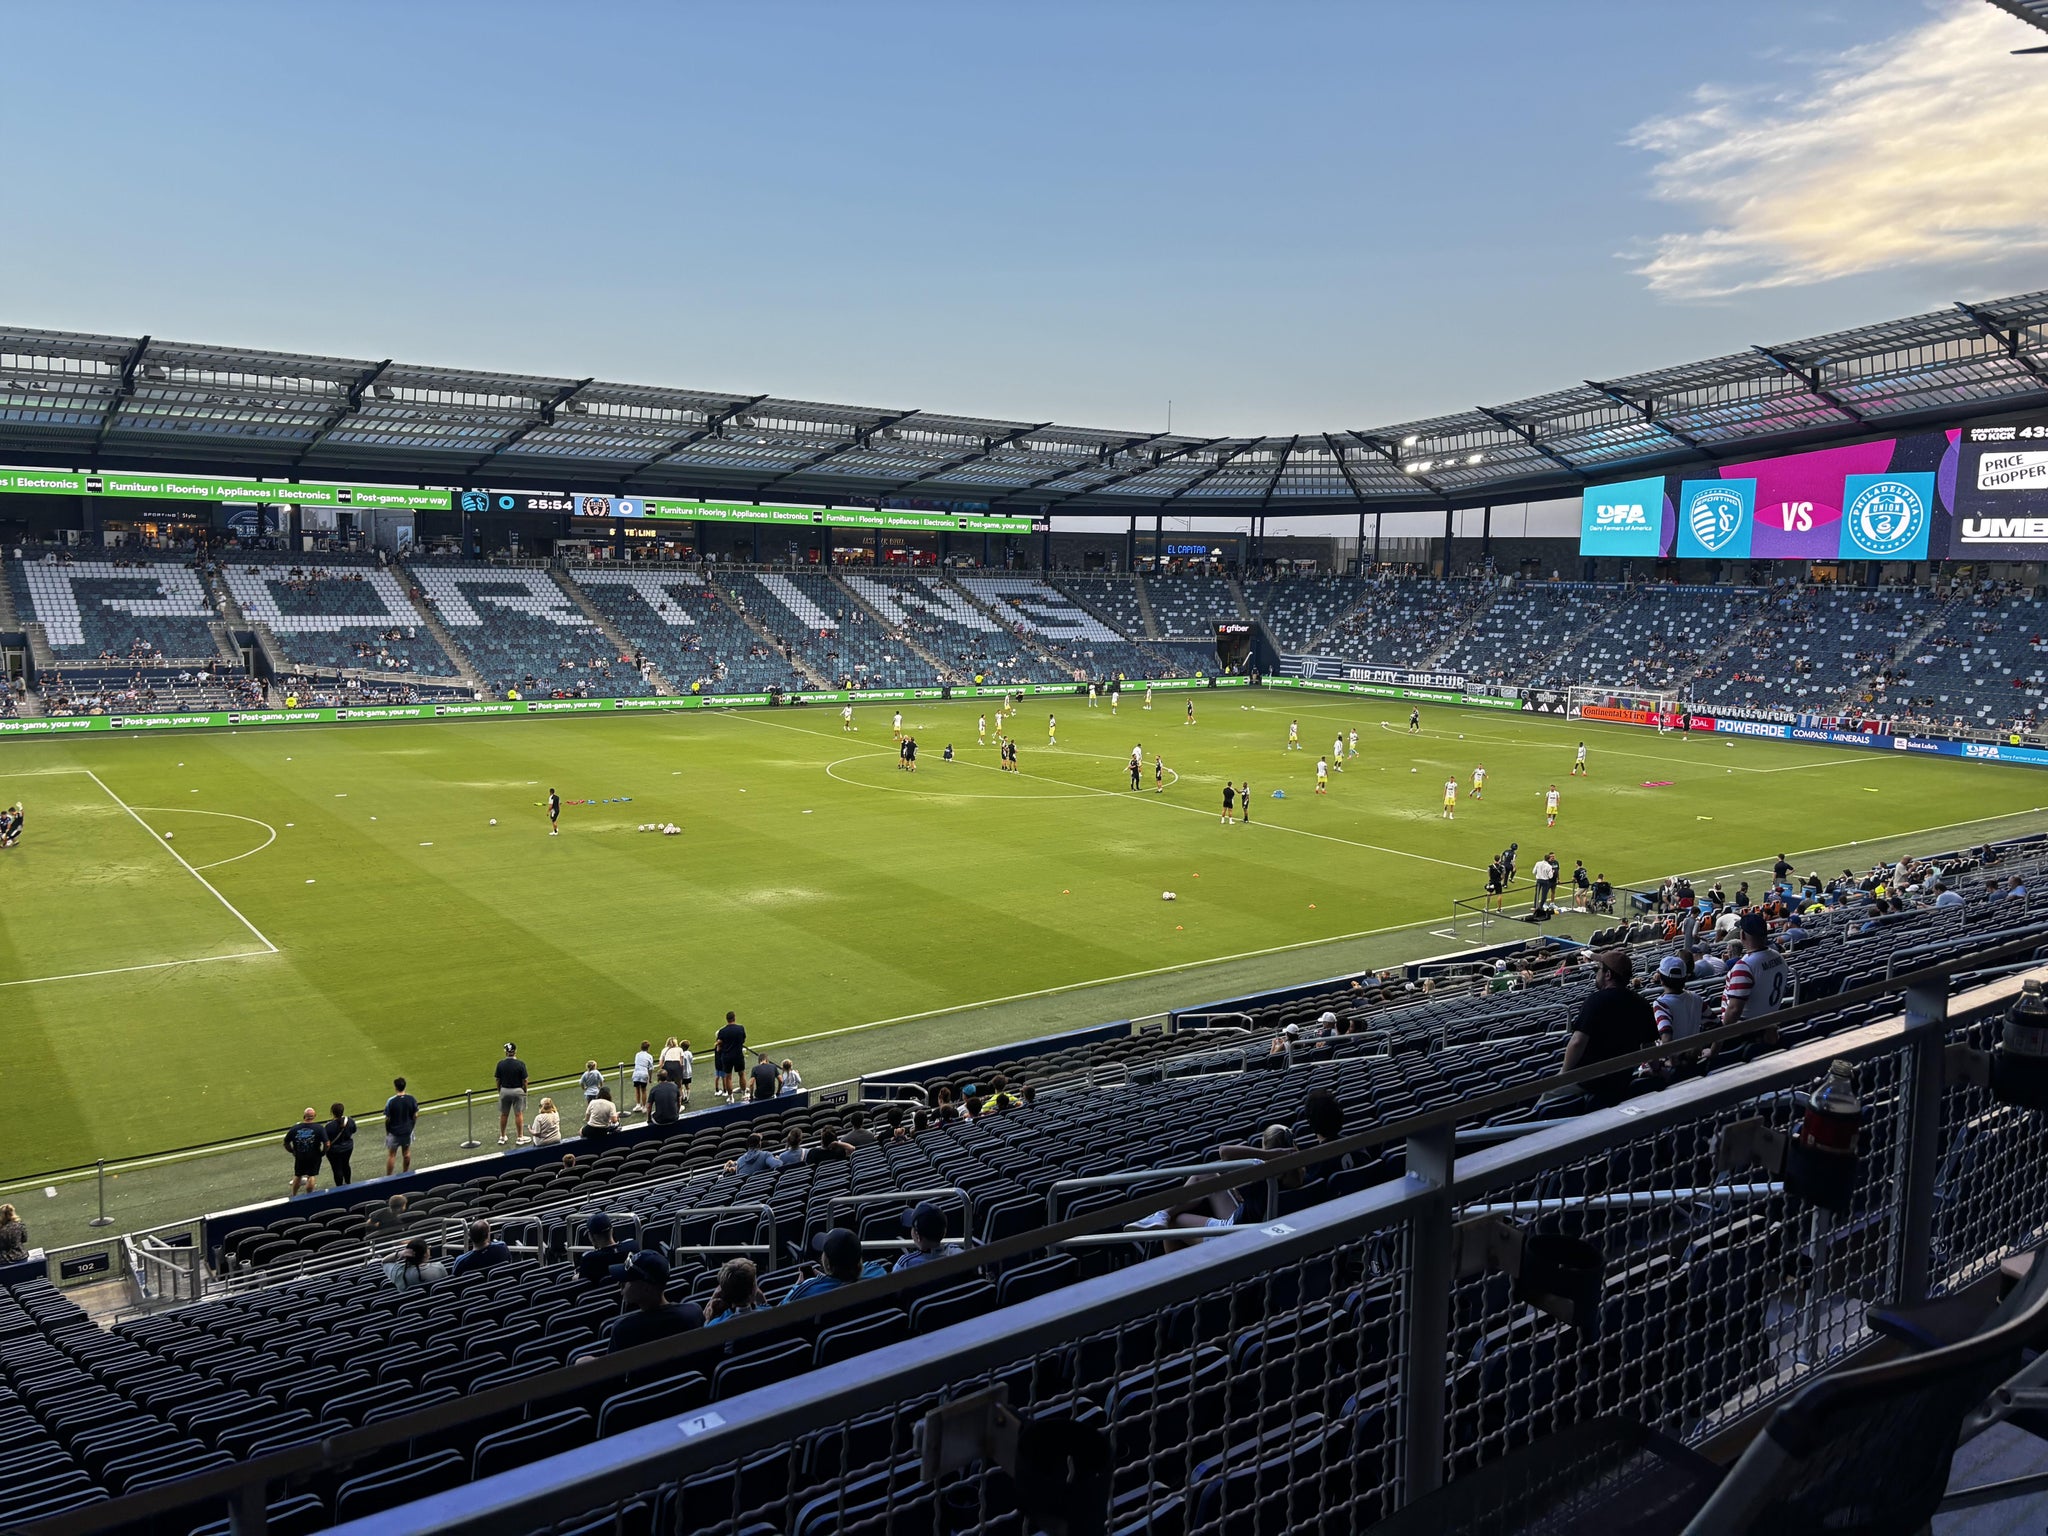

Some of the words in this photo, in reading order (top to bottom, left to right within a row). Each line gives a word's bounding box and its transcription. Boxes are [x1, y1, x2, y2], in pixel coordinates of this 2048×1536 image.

[1988, 432, 2015, 440] KICK
[1986, 454, 2024, 472] PRICE
[1982, 465, 2046, 487] CHOPPER
[17, 478, 78, 489] Electronics
[110, 482, 158, 492] Furniture
[166, 484, 209, 496] Flooring
[216, 486, 271, 498] Appliances
[278, 490, 331, 500] Electronics
[356, 493, 408, 504] Post-game,
[408, 496, 429, 505] your
[430, 496, 448, 506] way
[499, 496, 515, 510] 0
[528, 499, 573, 511] 25:54
[1853, 486, 1920, 516] PHILADELPHIA
[618, 501, 633, 515] 0
[660, 506, 693, 515] Furniture
[698, 508, 727, 518] Flooring
[732, 510, 768, 520] Appliances
[773, 512, 809, 521] Electronics
[1873, 503, 1900, 512] UNION
[826, 514, 854, 523] Furniture
[859, 516, 883, 525] Flooring
[888, 518, 920, 526] Appliances
[924, 519, 955, 527] Electronics
[1782, 502, 1813, 532] VS
[969, 521, 1000, 530] Post-game,
[1016, 523, 1029, 531] way
[1168, 545, 1176, 553] EL
[1178, 545, 1206, 554] CAPITAN
[241, 713, 284, 722] Post-game,
[303, 712, 320, 720] way
[348, 710, 387, 718] Post-game,
[388, 709, 404, 717] your
[1584, 707, 1622, 718] Continental
[1, 722, 49, 730] Post-game,
[51, 720, 71, 729] your
[72, 719, 91, 729] way
[124, 717, 171, 726] Post-game,
[172, 716, 192, 725] your
[192, 716, 210, 725] way
[1717, 720, 1785, 736] POWERADE
[1792, 729, 1828, 740] COMPASS
[1832, 733, 1870, 744] MINERALS
[1768, 972, 1783, 1007] 8
[77, 1263, 94, 1272] 102
[693, 1418, 706, 1429] 7
